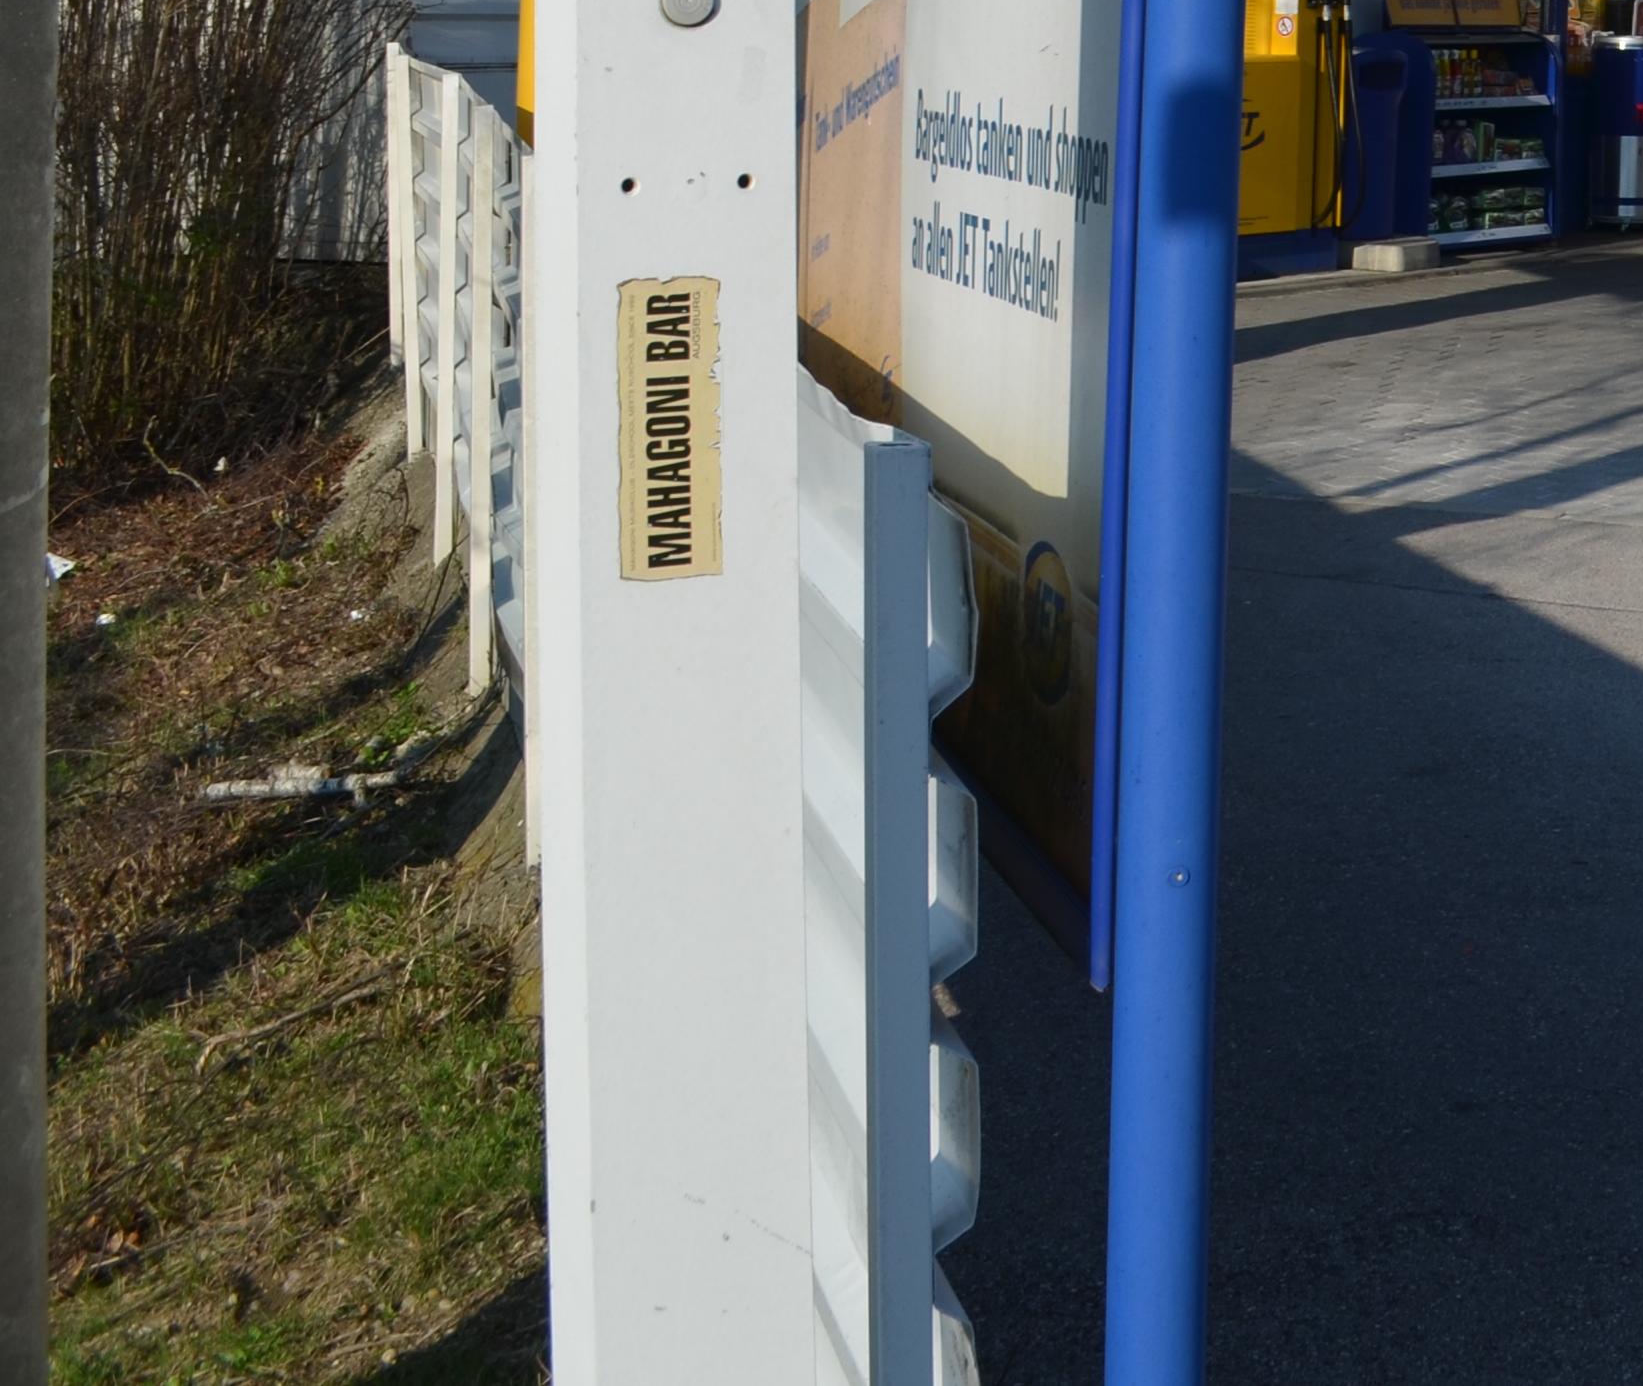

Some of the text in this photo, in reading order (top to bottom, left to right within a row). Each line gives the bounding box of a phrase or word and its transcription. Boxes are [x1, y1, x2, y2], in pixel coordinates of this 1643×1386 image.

[915, 88, 1109, 225] Bargeldlos tanken und shoppen
[692, 291, 701, 360] AUGSBURG
[912, 200, 1062, 323] an allen JET Tankstellen!
[646, 292, 692, 569] MAHAGONI BAR
